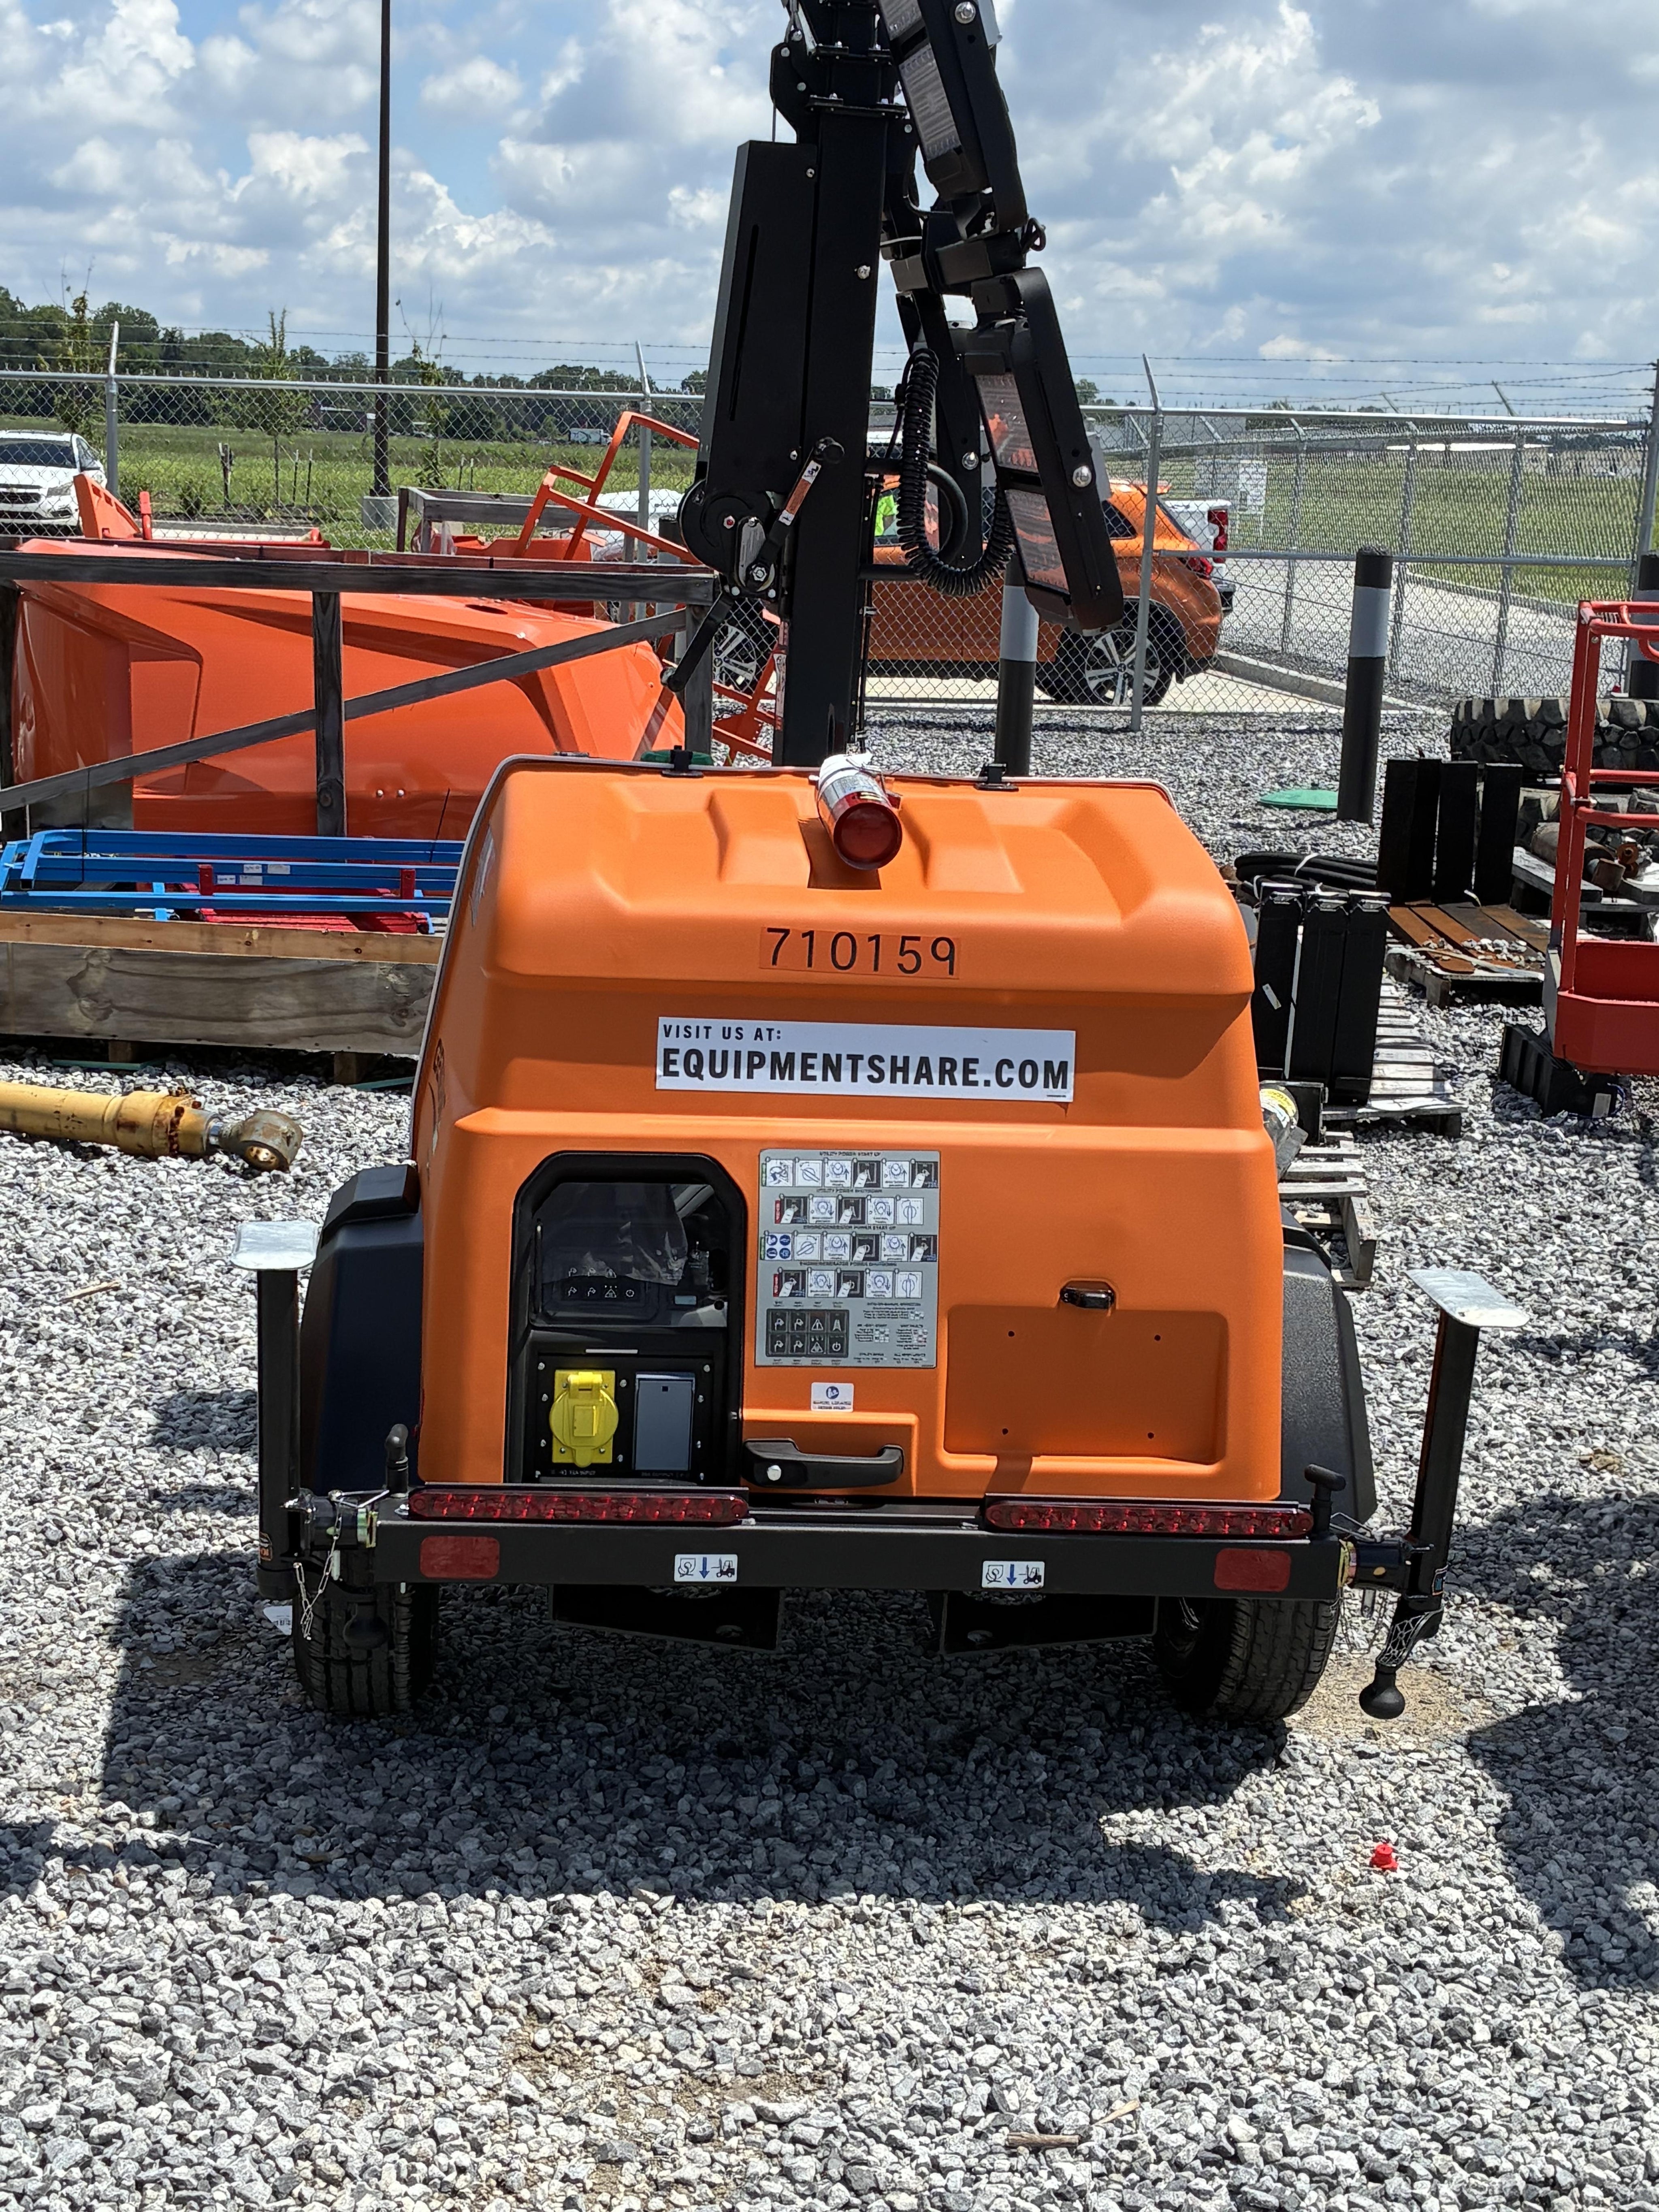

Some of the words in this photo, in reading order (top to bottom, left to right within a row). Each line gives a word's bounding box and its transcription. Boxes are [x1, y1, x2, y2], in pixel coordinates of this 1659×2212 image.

[766, 927, 955, 976] 710159
[663, 1024, 712, 1040] VISIT
[722, 1026, 744, 1041] US
[753, 1027, 782, 1042] AT:
[663, 1047, 1068, 1090] EQUIPMENTSHARE.COM
